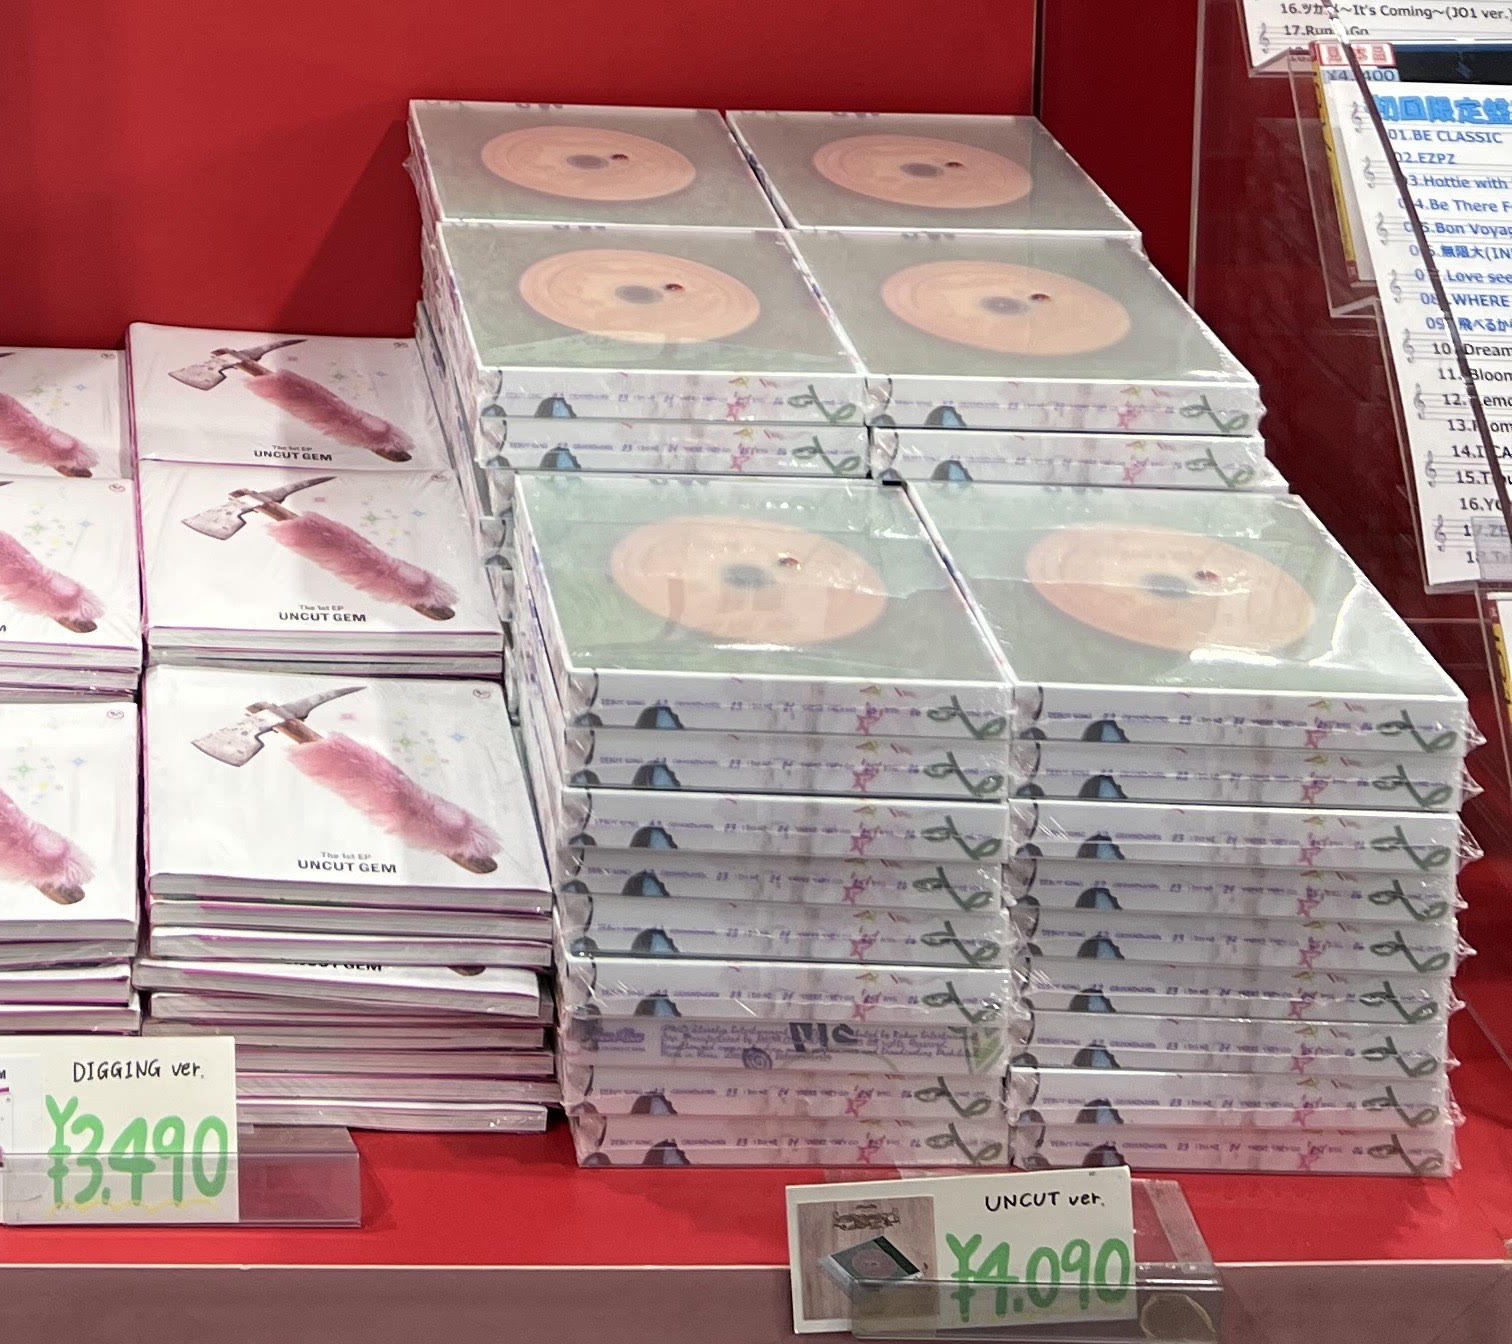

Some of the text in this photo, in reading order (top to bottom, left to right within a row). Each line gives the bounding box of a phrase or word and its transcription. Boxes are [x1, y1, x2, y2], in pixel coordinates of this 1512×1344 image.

[1438, 130, 1503, 144] CLASSIC
[1408, 175, 1507, 189] 3.Hottie with
[1454, 199, 1503, 212] There
[254, 450, 332, 461] UNCUT GEM
[279, 612, 367, 622] UNCUT GEM
[298, 860, 397, 873] UNCUT GEM
[73, 1059, 205, 1083] DIGGING ver.
[985, 1191, 1105, 1212] UNCUT ver.
